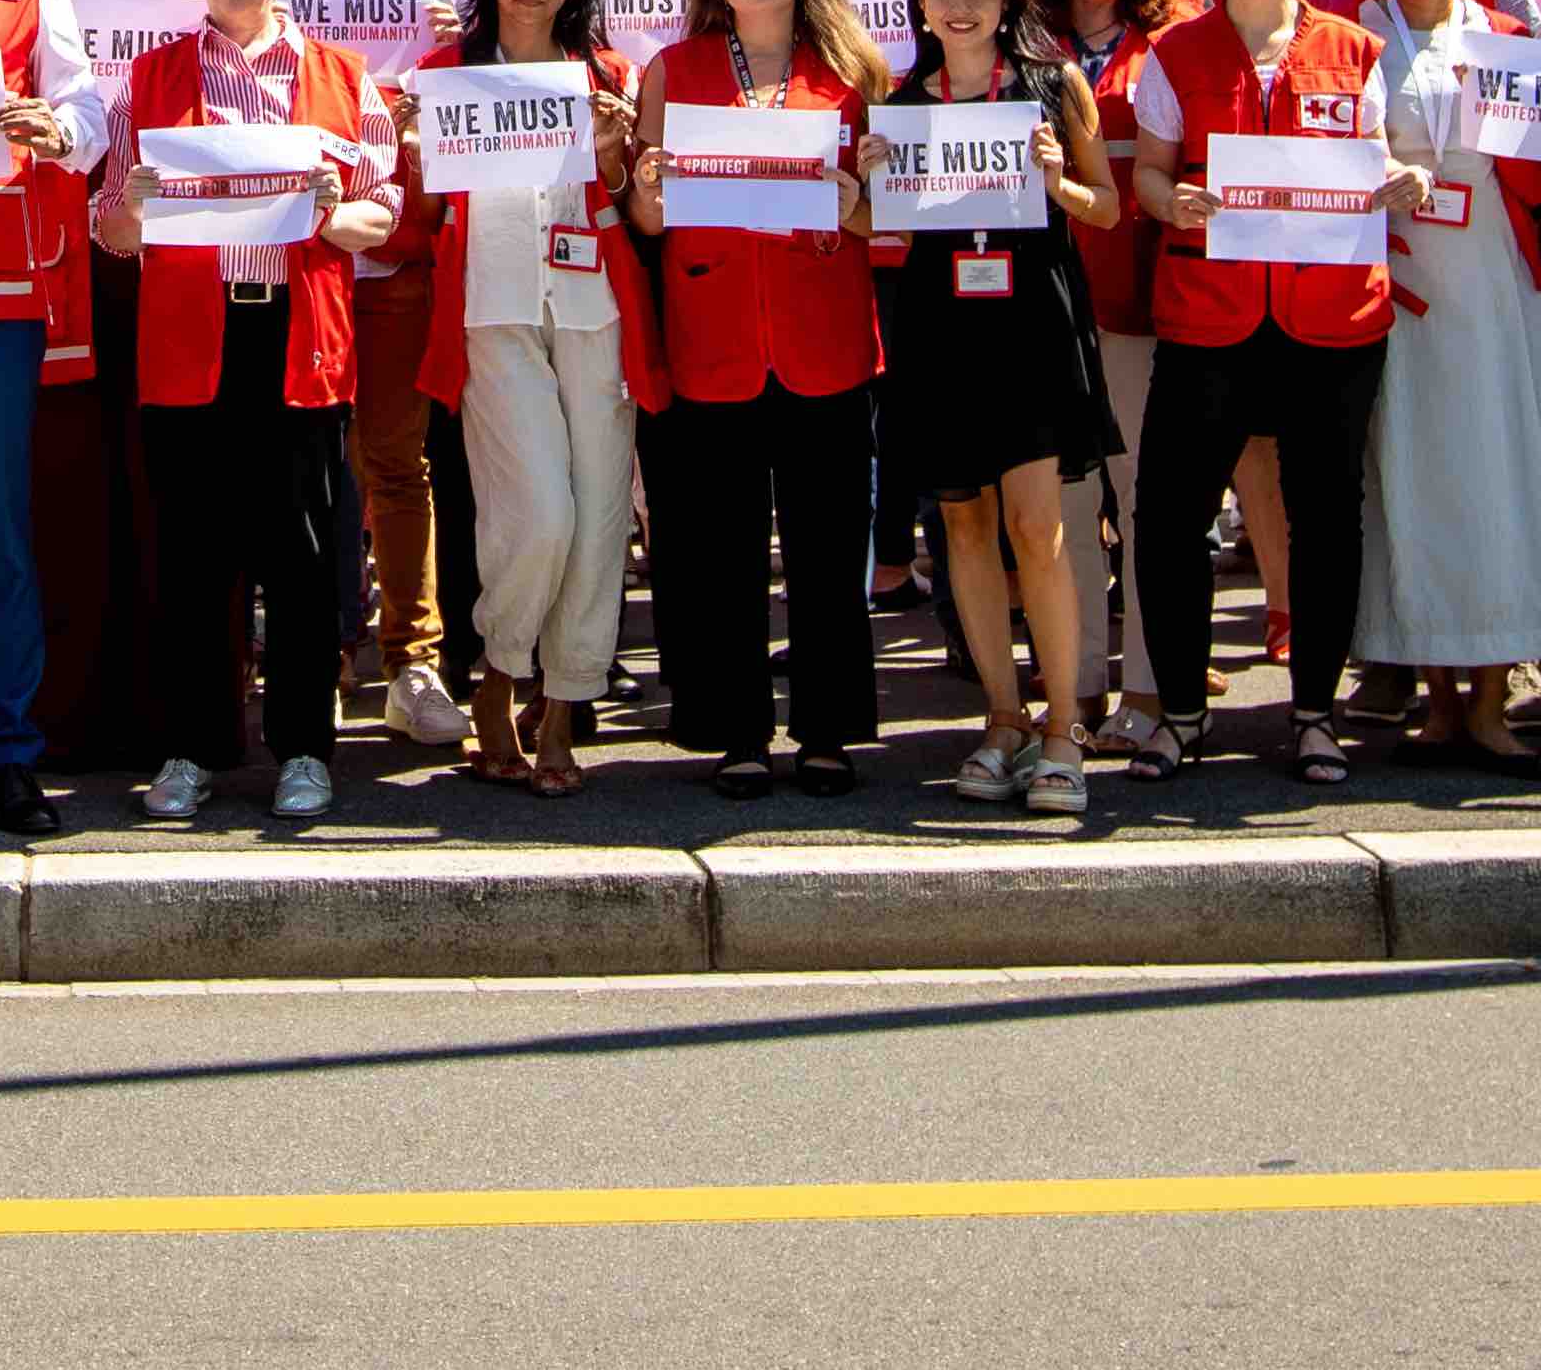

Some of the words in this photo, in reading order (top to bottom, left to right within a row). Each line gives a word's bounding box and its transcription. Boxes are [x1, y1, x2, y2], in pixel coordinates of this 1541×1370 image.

[1478, 69, 1521, 102] WE
[436, 105, 479, 136] WE
[494, 96, 576, 130] MUST
[437, 130, 577, 156] #ACTFORHUMANITY
[682, 158, 822, 178] #PROTECTHUMANITY
[887, 143, 926, 174] WE
[942, 140, 1026, 173] MUST
[885, 175, 1028, 192] #PROTECTHUMANITY
[1228, 189, 1366, 211] #ACTFORHUMANITY
